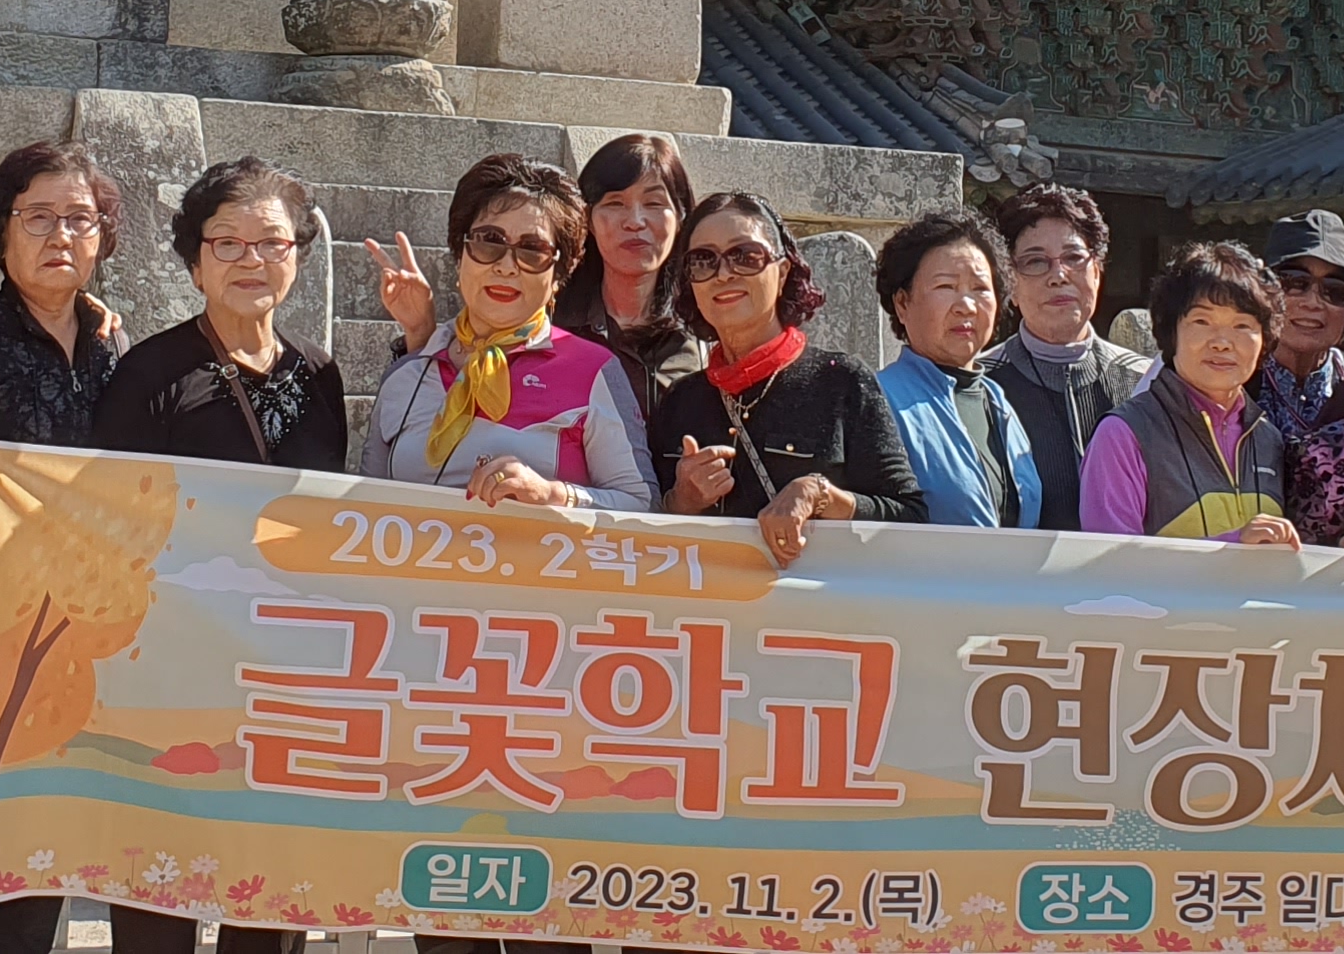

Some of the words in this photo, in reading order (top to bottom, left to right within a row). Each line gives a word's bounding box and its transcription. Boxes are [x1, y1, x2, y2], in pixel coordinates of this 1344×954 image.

[329, 509, 516, 577] 2023.
[539, 531, 704, 591] 2학기
[239, 602, 903, 814] 글꽃학교
[426, 852, 527, 907] 일자
[567, 863, 711, 916] 2023.
[725, 874, 797, 920] 11.
[1038, 872, 1130, 925] 장소
[1174, 873, 1265, 925] 경주
